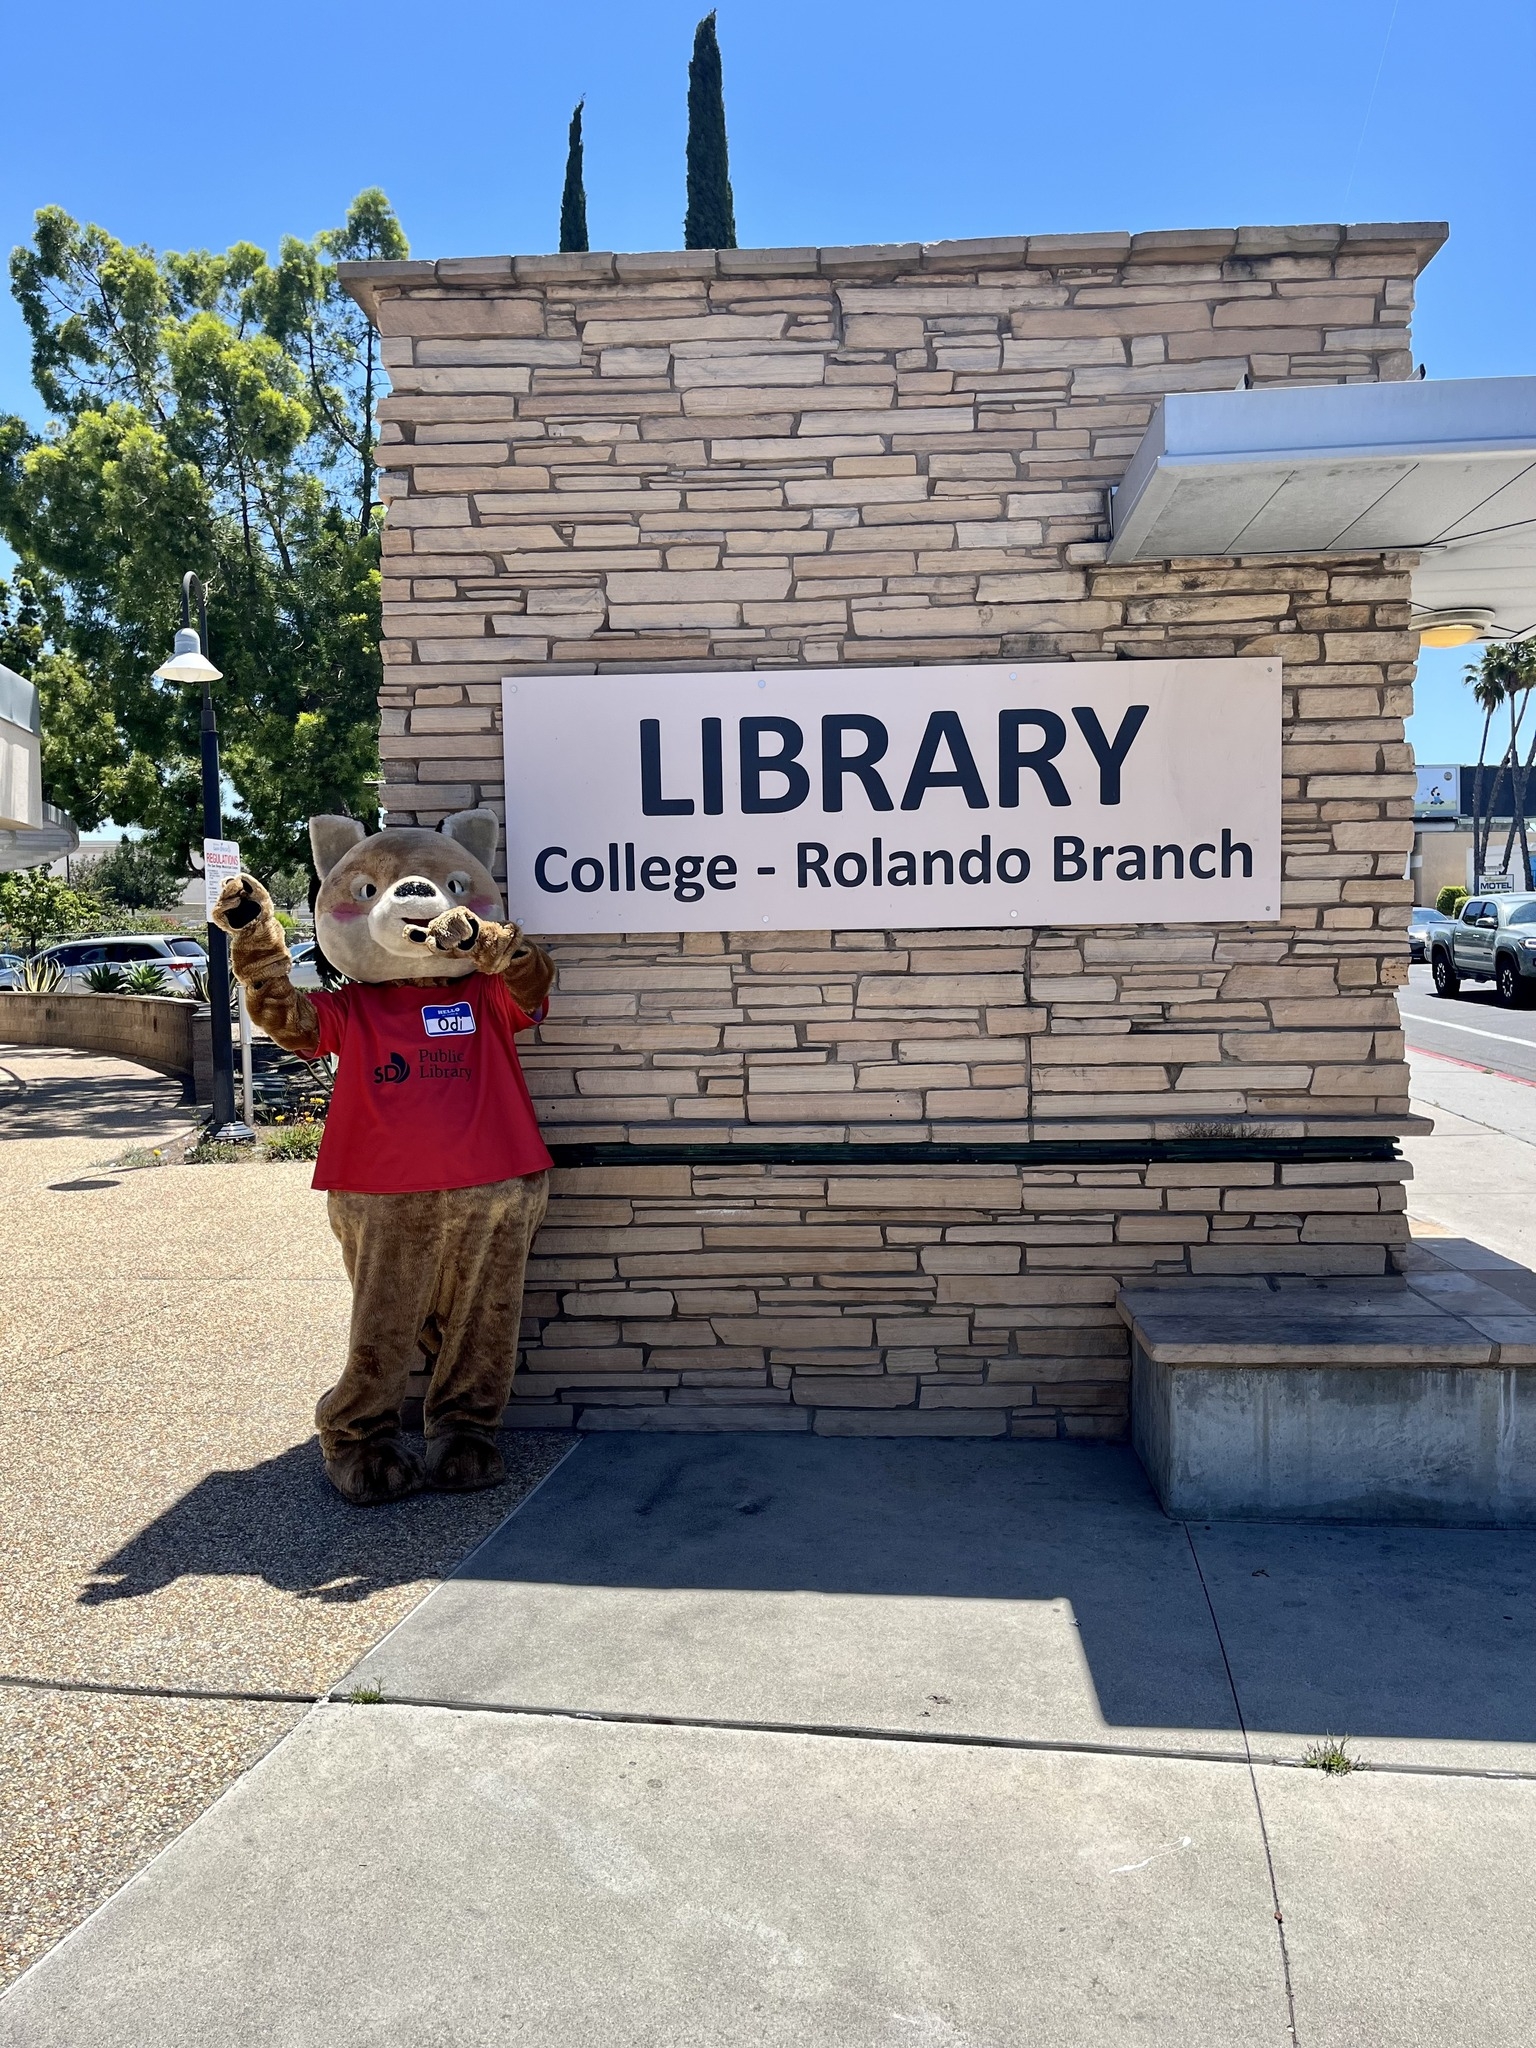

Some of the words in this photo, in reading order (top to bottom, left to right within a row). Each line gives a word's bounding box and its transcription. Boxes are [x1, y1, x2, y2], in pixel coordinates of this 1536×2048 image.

[639, 704, 1150, 817] LIBRARY
[206, 852, 239, 866] REGULATIONS
[534, 842, 738, 903] College
[757, 866, 776, 876] -
[797, 834, 1031, 889] Rolando
[1053, 828, 1253, 882] Branch
[1480, 882, 1512, 890] MOTEL
[437, 1007, 460, 1015] HELLO
[437, 1015, 463, 1032] Odi
[419, 1049, 465, 1063] Public
[420, 1065, 472, 1081] Library
